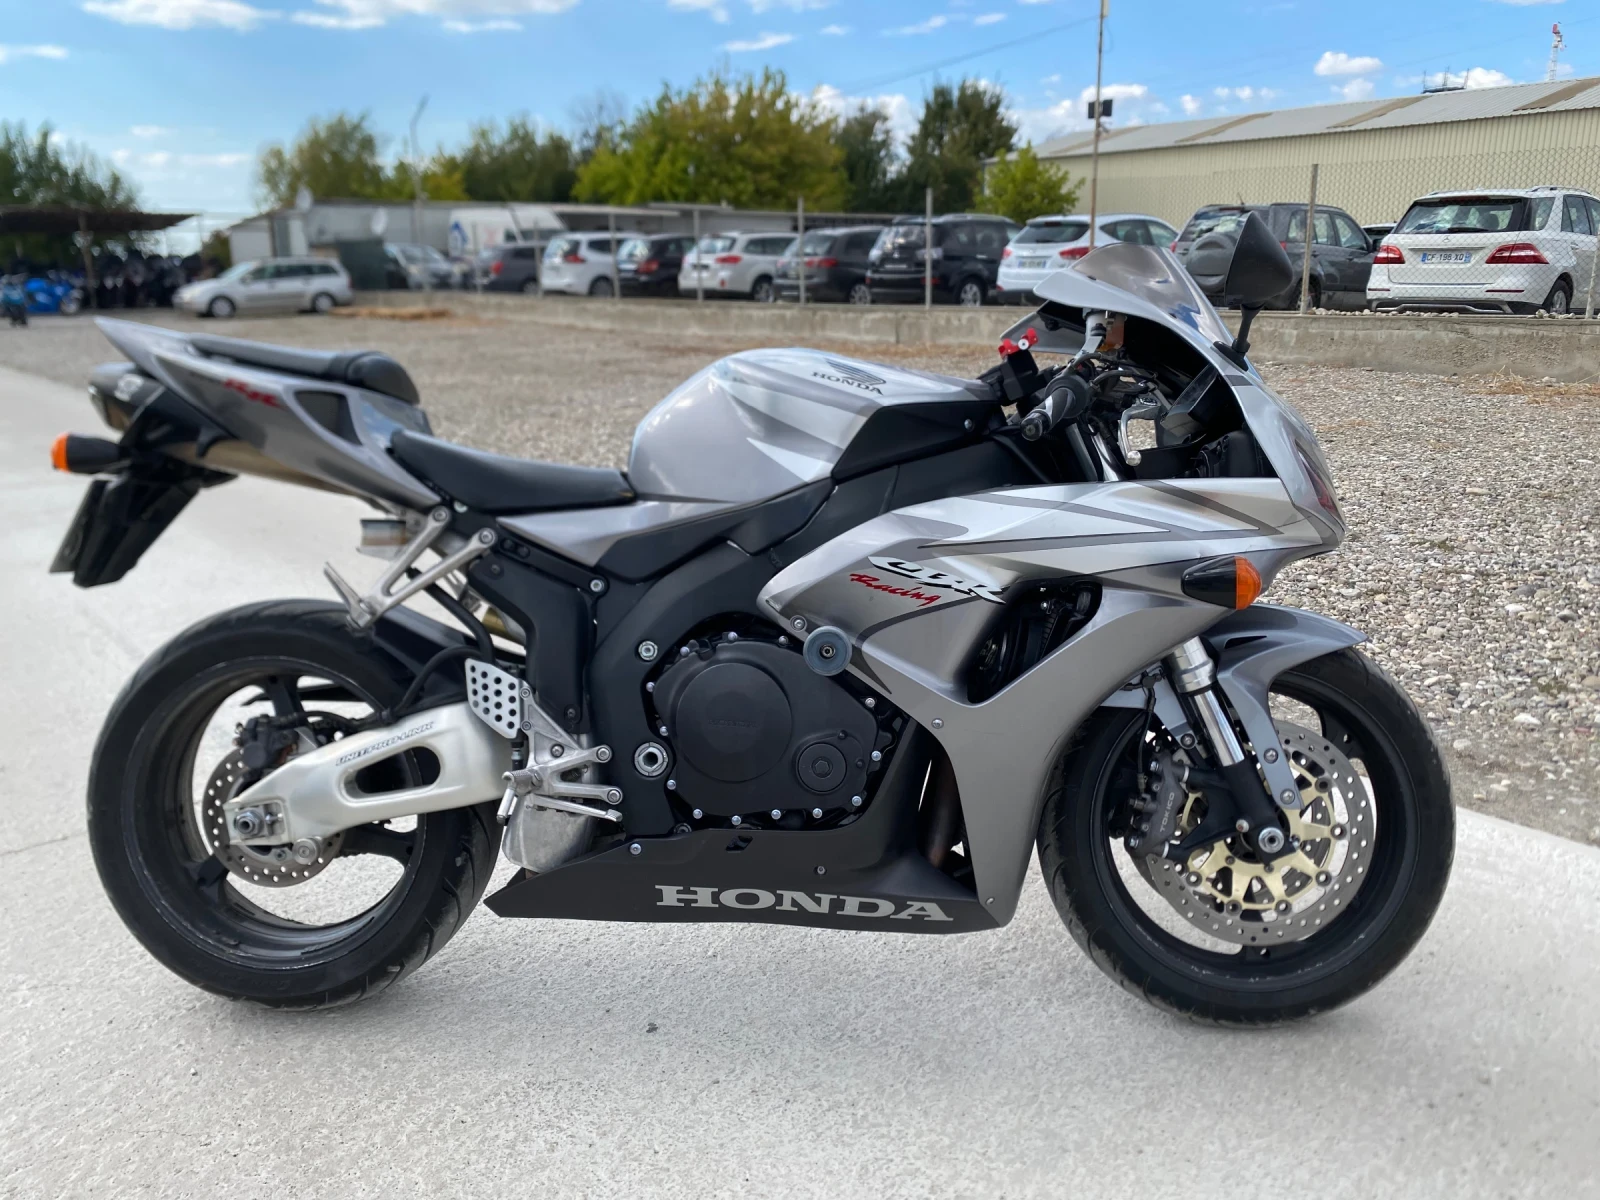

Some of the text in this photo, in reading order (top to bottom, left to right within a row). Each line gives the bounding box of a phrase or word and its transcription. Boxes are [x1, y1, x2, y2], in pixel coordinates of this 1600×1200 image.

[812, 372, 884, 396] HONDA
[849, 573, 942, 608] Racing
[867, 556, 1007, 605] CBR
[1159, 791, 1175, 833] TOKICO
[654, 884, 954, 921] HONDA
